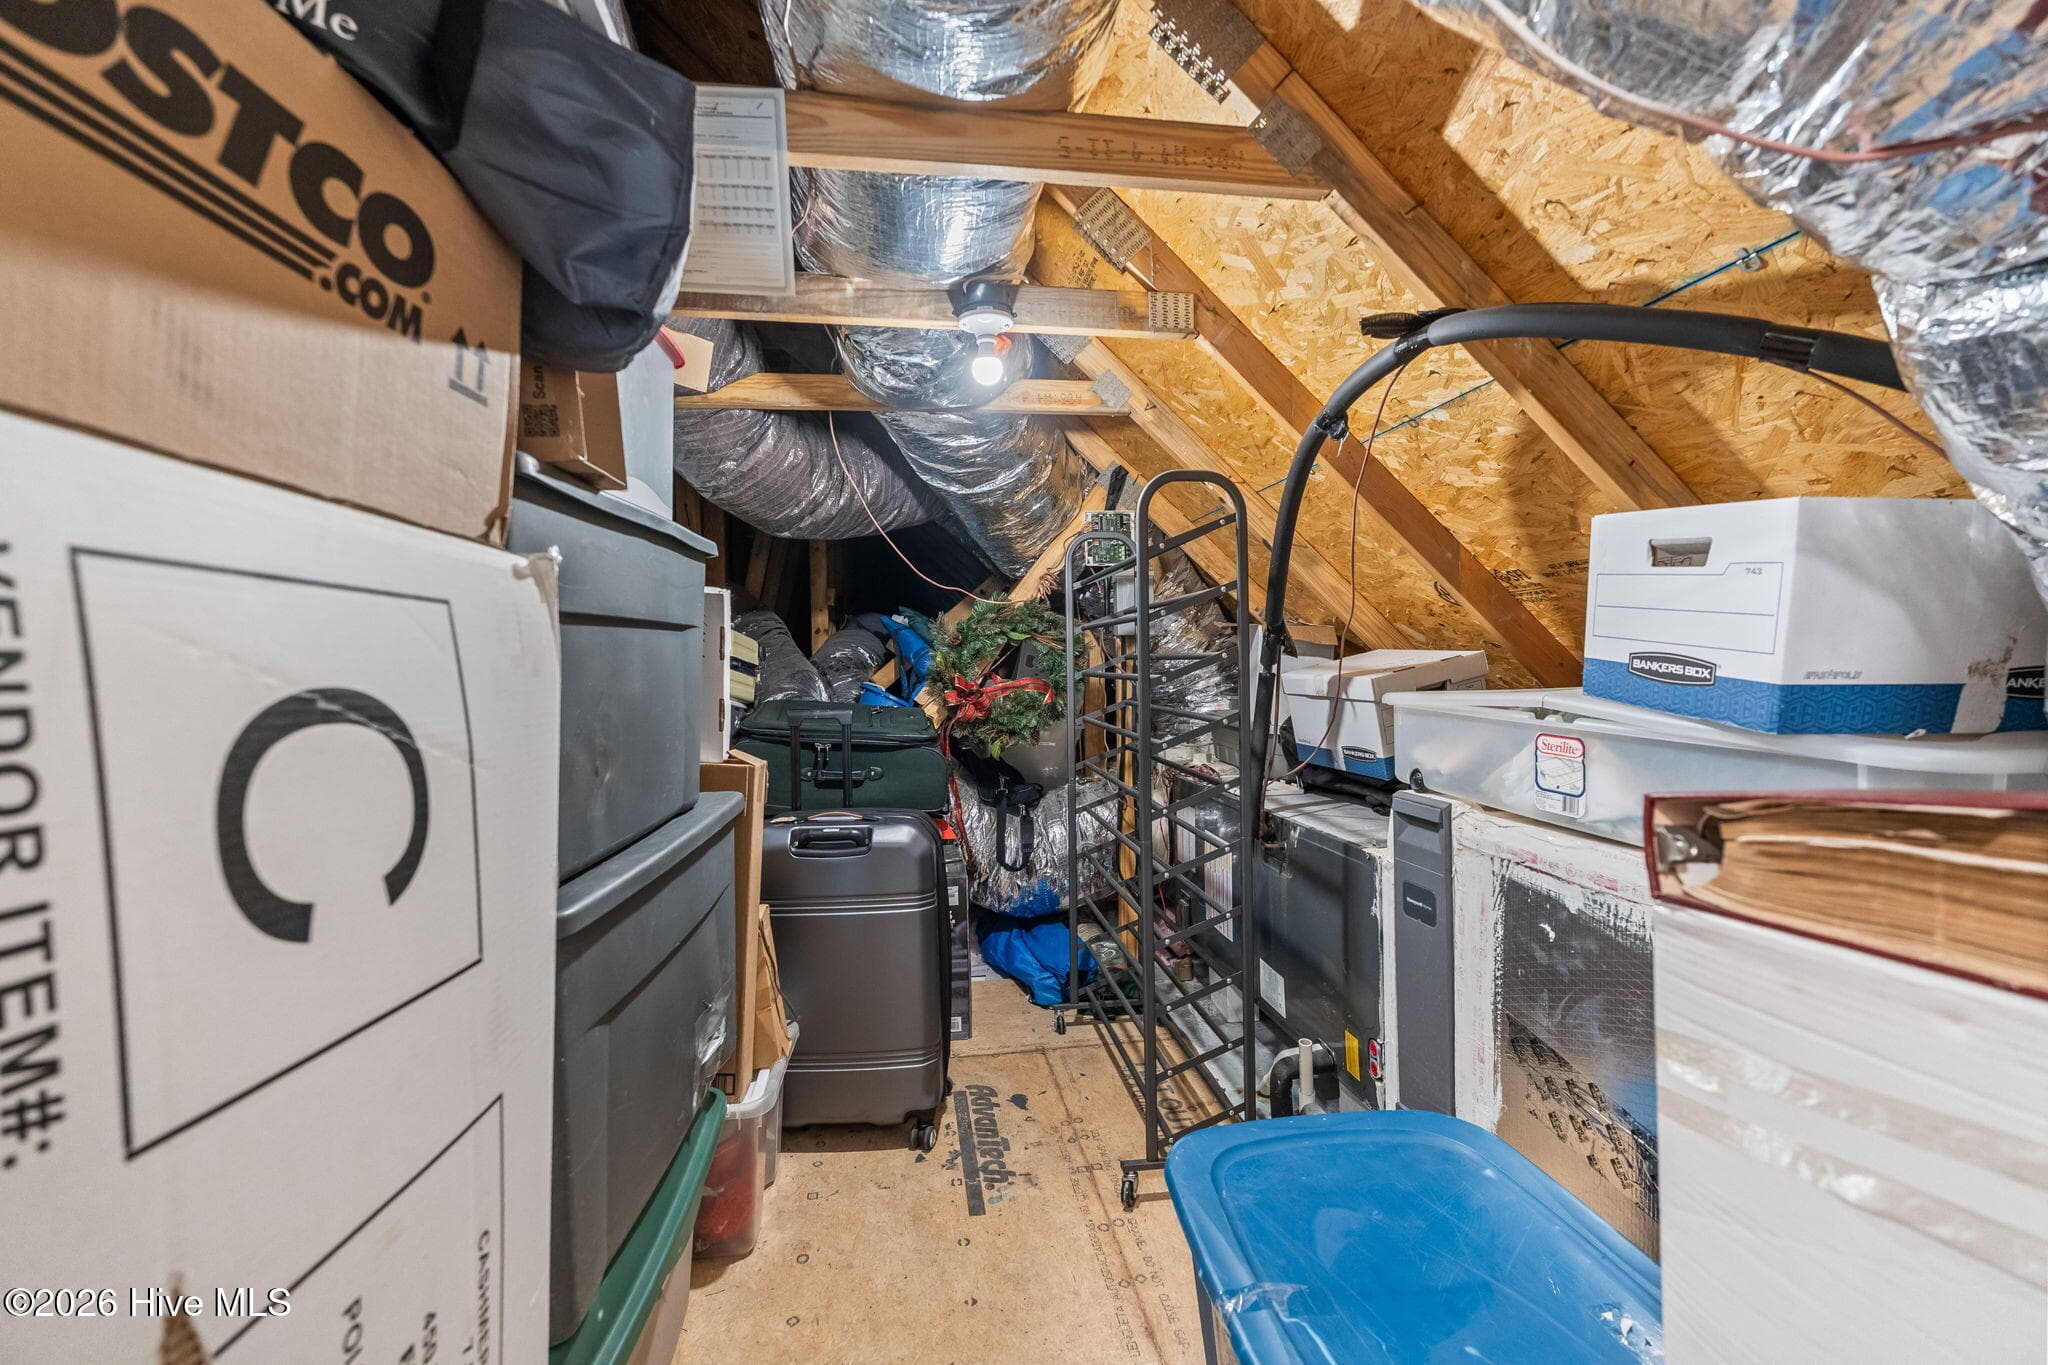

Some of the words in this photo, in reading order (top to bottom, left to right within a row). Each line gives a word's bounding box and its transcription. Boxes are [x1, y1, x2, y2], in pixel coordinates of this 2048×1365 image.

[319, 262, 423, 344] .COM
[533, 365, 546, 399] Scan
[1745, 567, 1763, 576] 743
[1632, 658, 1685, 677] BANKERS
[1684, 666, 1712, 680] BOX
[2007, 677, 2046, 690] ANKE
[1541, 737, 1578, 755] Sterilite
[217, 687, 429, 943] C
[0, 902, 65, 1169] ITEM#:
[964, 1084, 1017, 1185] AdvanTech
[1150, 1270, 1165, 1289] NOT
[1158, 1293, 1180, 1325] CLOSE
